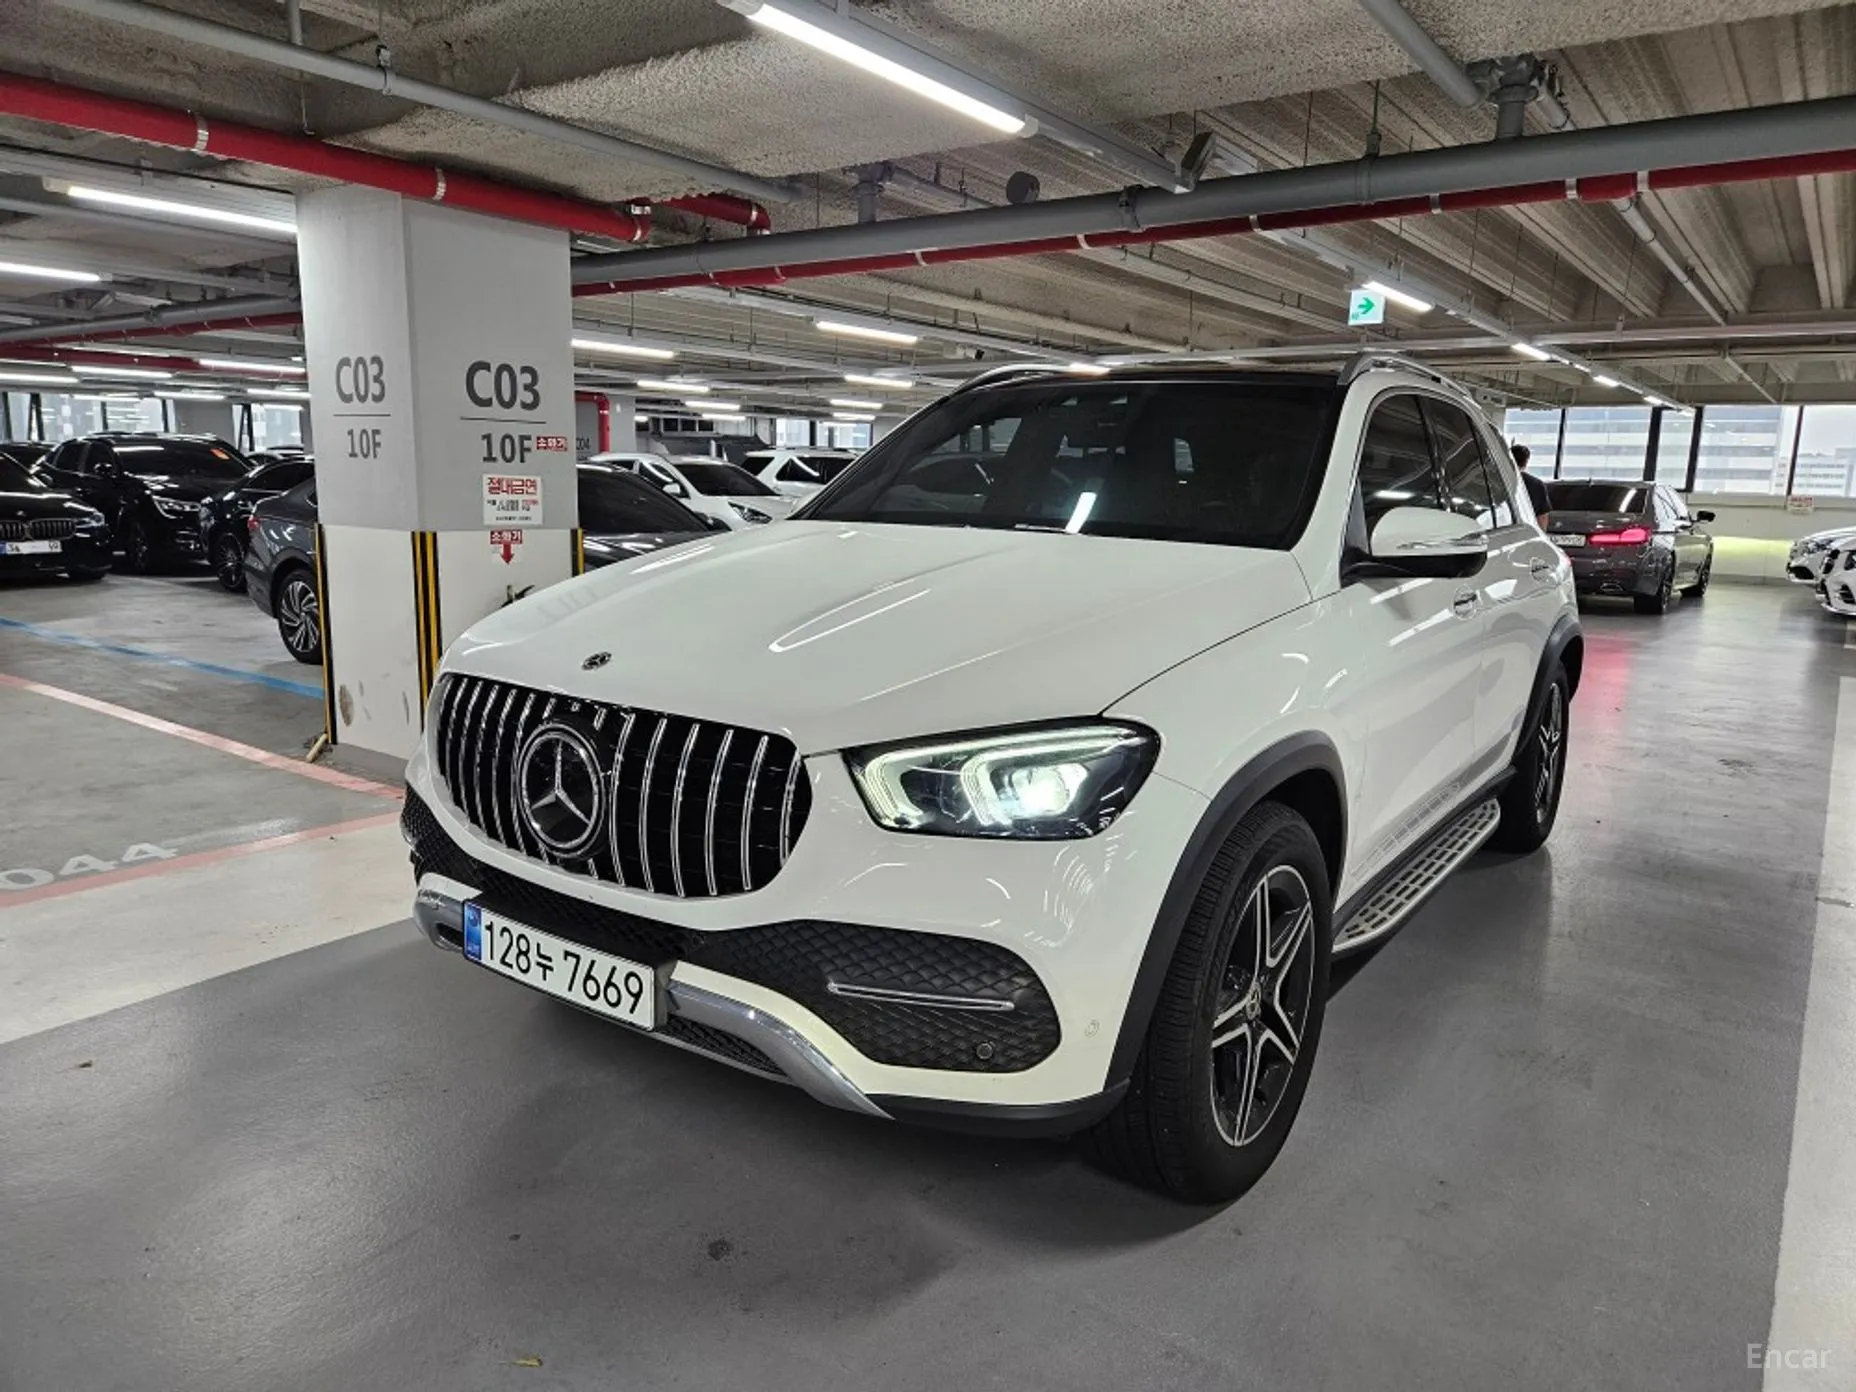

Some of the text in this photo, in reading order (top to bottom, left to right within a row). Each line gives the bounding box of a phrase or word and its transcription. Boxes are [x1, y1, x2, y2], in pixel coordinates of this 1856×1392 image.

[336, 355, 386, 404] C03
[465, 360, 541, 411] C03
[347, 428, 382, 459] 10F
[481, 432, 532, 464] 10F
[487, 477, 538, 495] 절대금연
[485, 921, 644, 1014] 128누 7669
